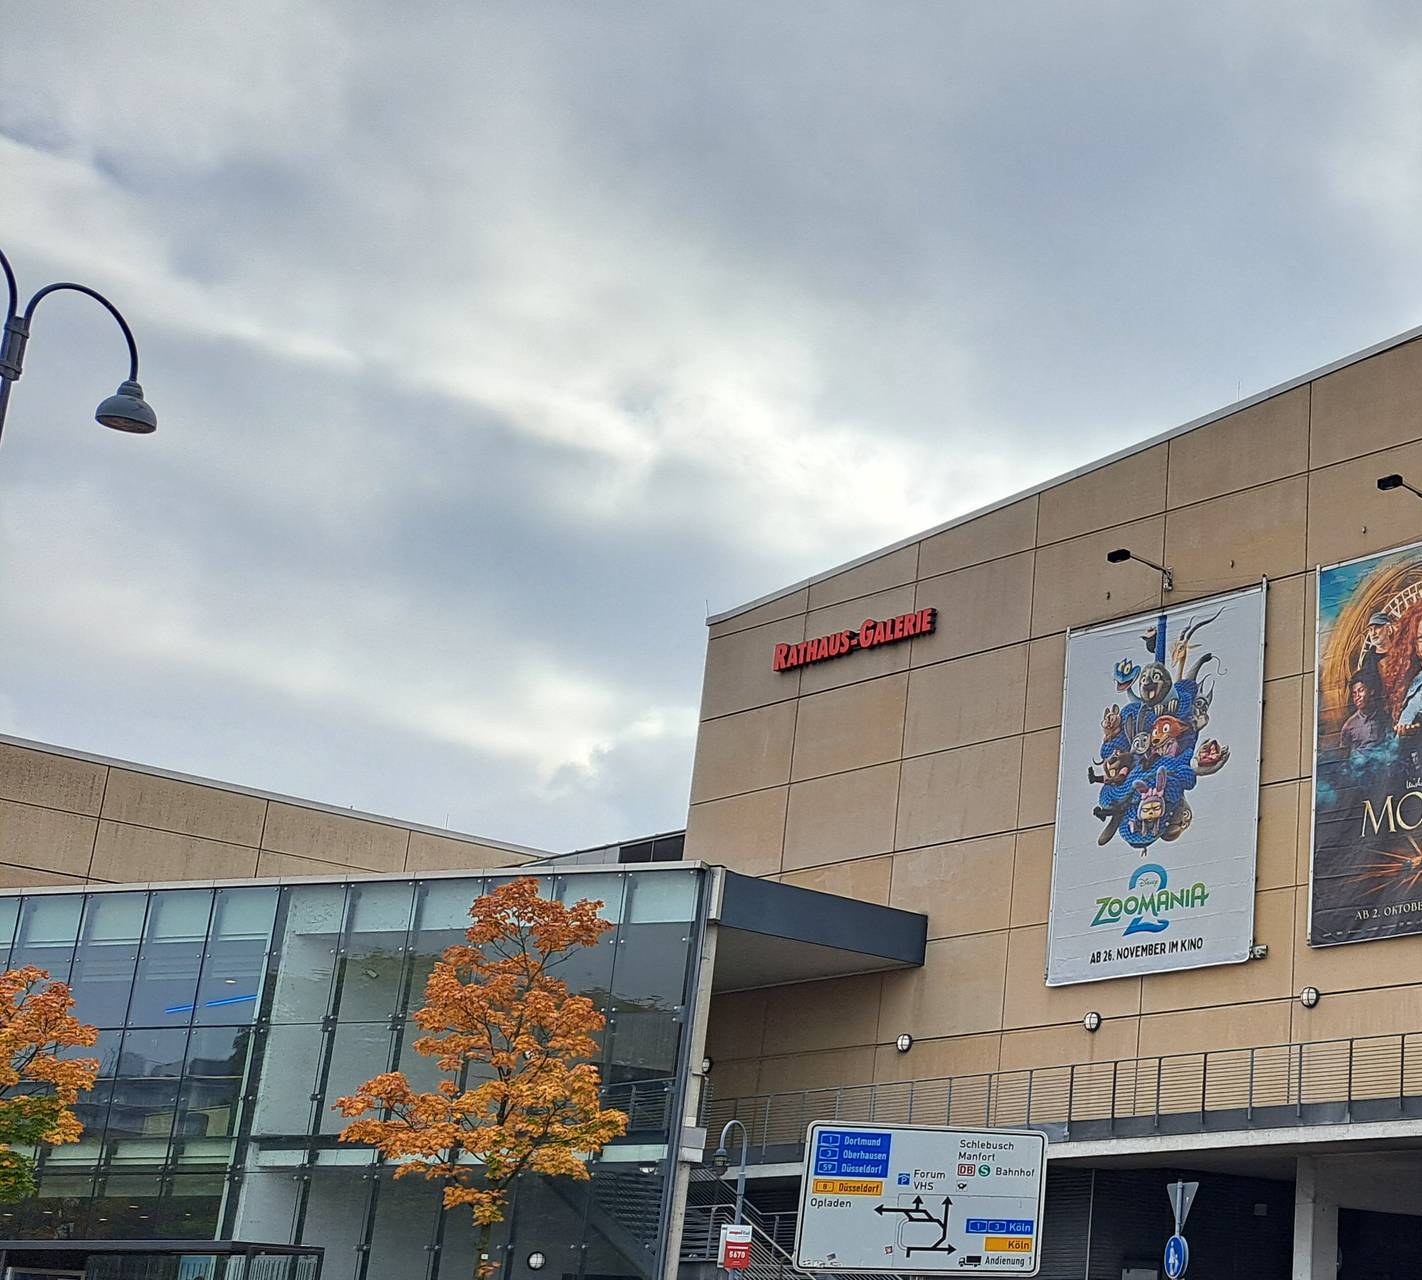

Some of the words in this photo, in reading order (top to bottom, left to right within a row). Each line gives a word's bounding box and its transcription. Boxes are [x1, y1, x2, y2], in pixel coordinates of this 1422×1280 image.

[1090, 882, 1209, 927] ZOOMANIA
[1354, 910, 1370, 921] AB
[1372, 908, 1381, 919] 2.
[1090, 951, 1102, 965] AB
[1116, 942, 1166, 961] NOVEMBER
[1168, 940, 1179, 954] IM
[1180, 937, 1204, 952] KINO
[844, 1136, 881, 1147] Dortmund
[959, 1140, 1014, 1150] Schlebusch
[842, 1149, 887, 1160] Oberhausen
[958, 1152, 996, 1162] Manfort
[841, 1163, 882, 1174] Düsseldorf
[959, 1166, 974, 1175] DB
[995, 1168, 1035, 1177] Bahnhof
[913, 1170, 946, 1180] Forum
[838, 1183, 879, 1193] Düsseldorf
[913, 1182, 934, 1191] VHS
[810, 1197, 852, 1209] Opladen
[1009, 1222, 1031, 1232] Köln
[1008, 1241, 1030, 1250] Köln
[985, 1256, 1025, 1267] Andienung
